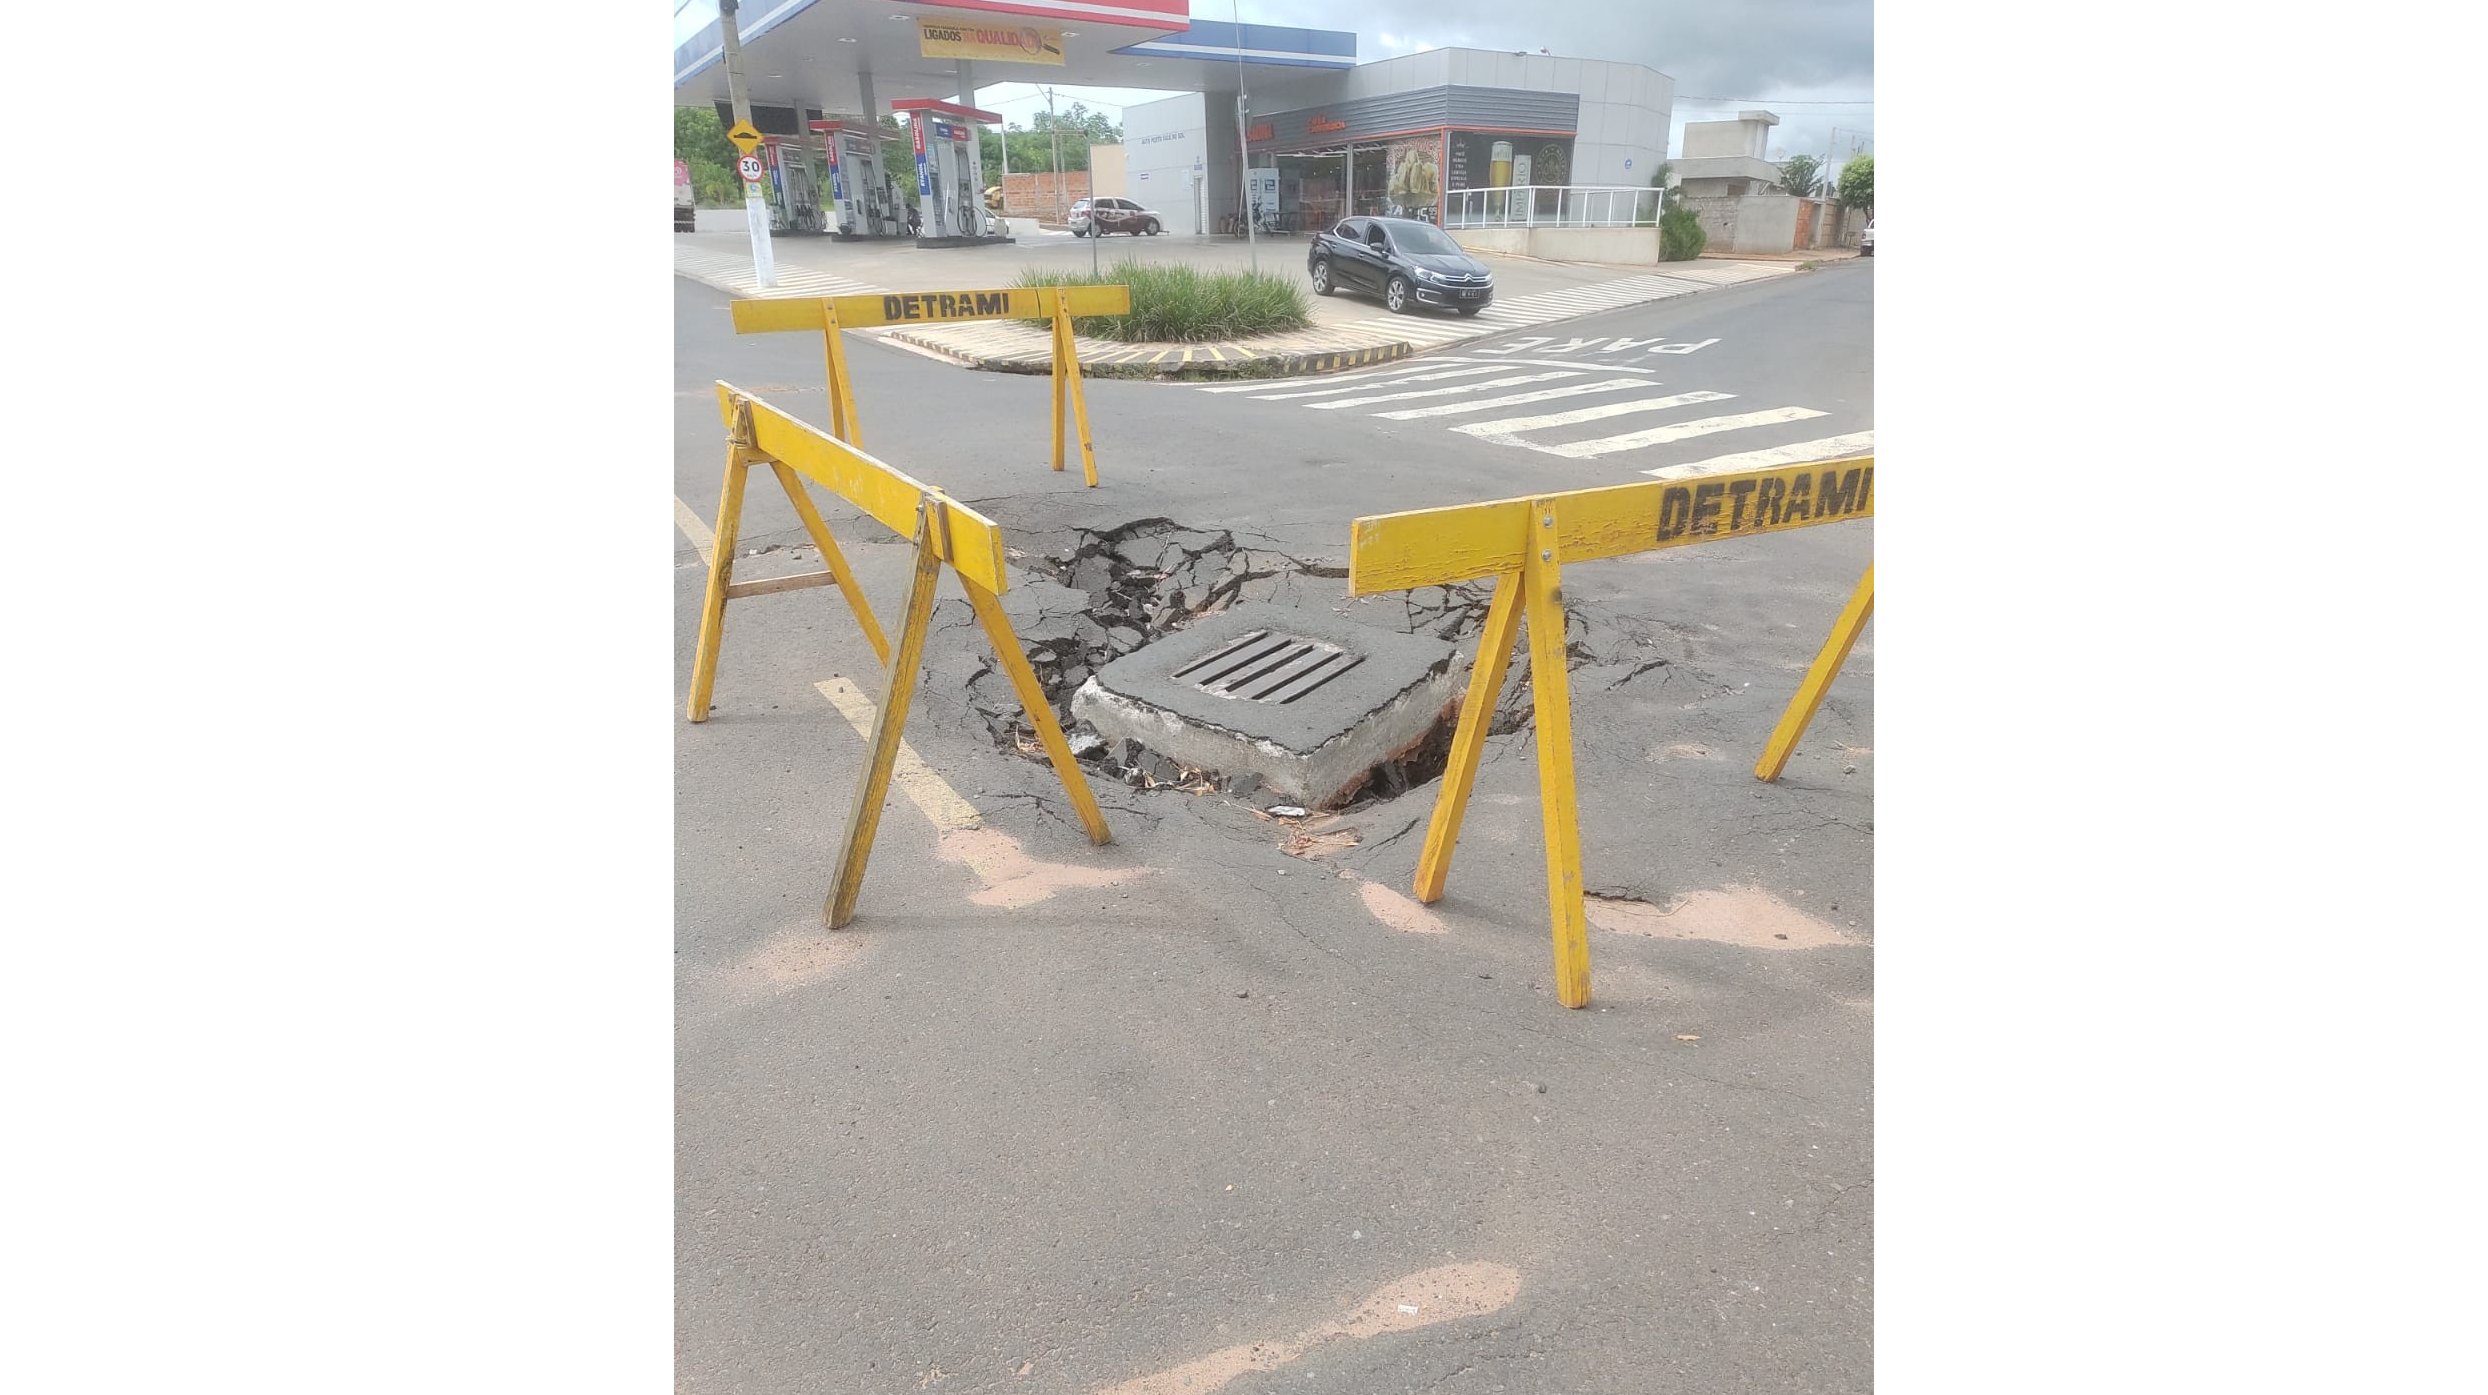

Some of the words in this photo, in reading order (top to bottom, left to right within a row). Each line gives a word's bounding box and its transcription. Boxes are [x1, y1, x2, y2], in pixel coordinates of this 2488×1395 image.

[923, 28, 962, 41] LIGADOS
[742, 161, 760, 172] 30
[883, 293, 1009, 320] DETRAMI
[1473, 337, 1722, 354] PARE
[1657, 467, 1874, 541] DETRAMI
